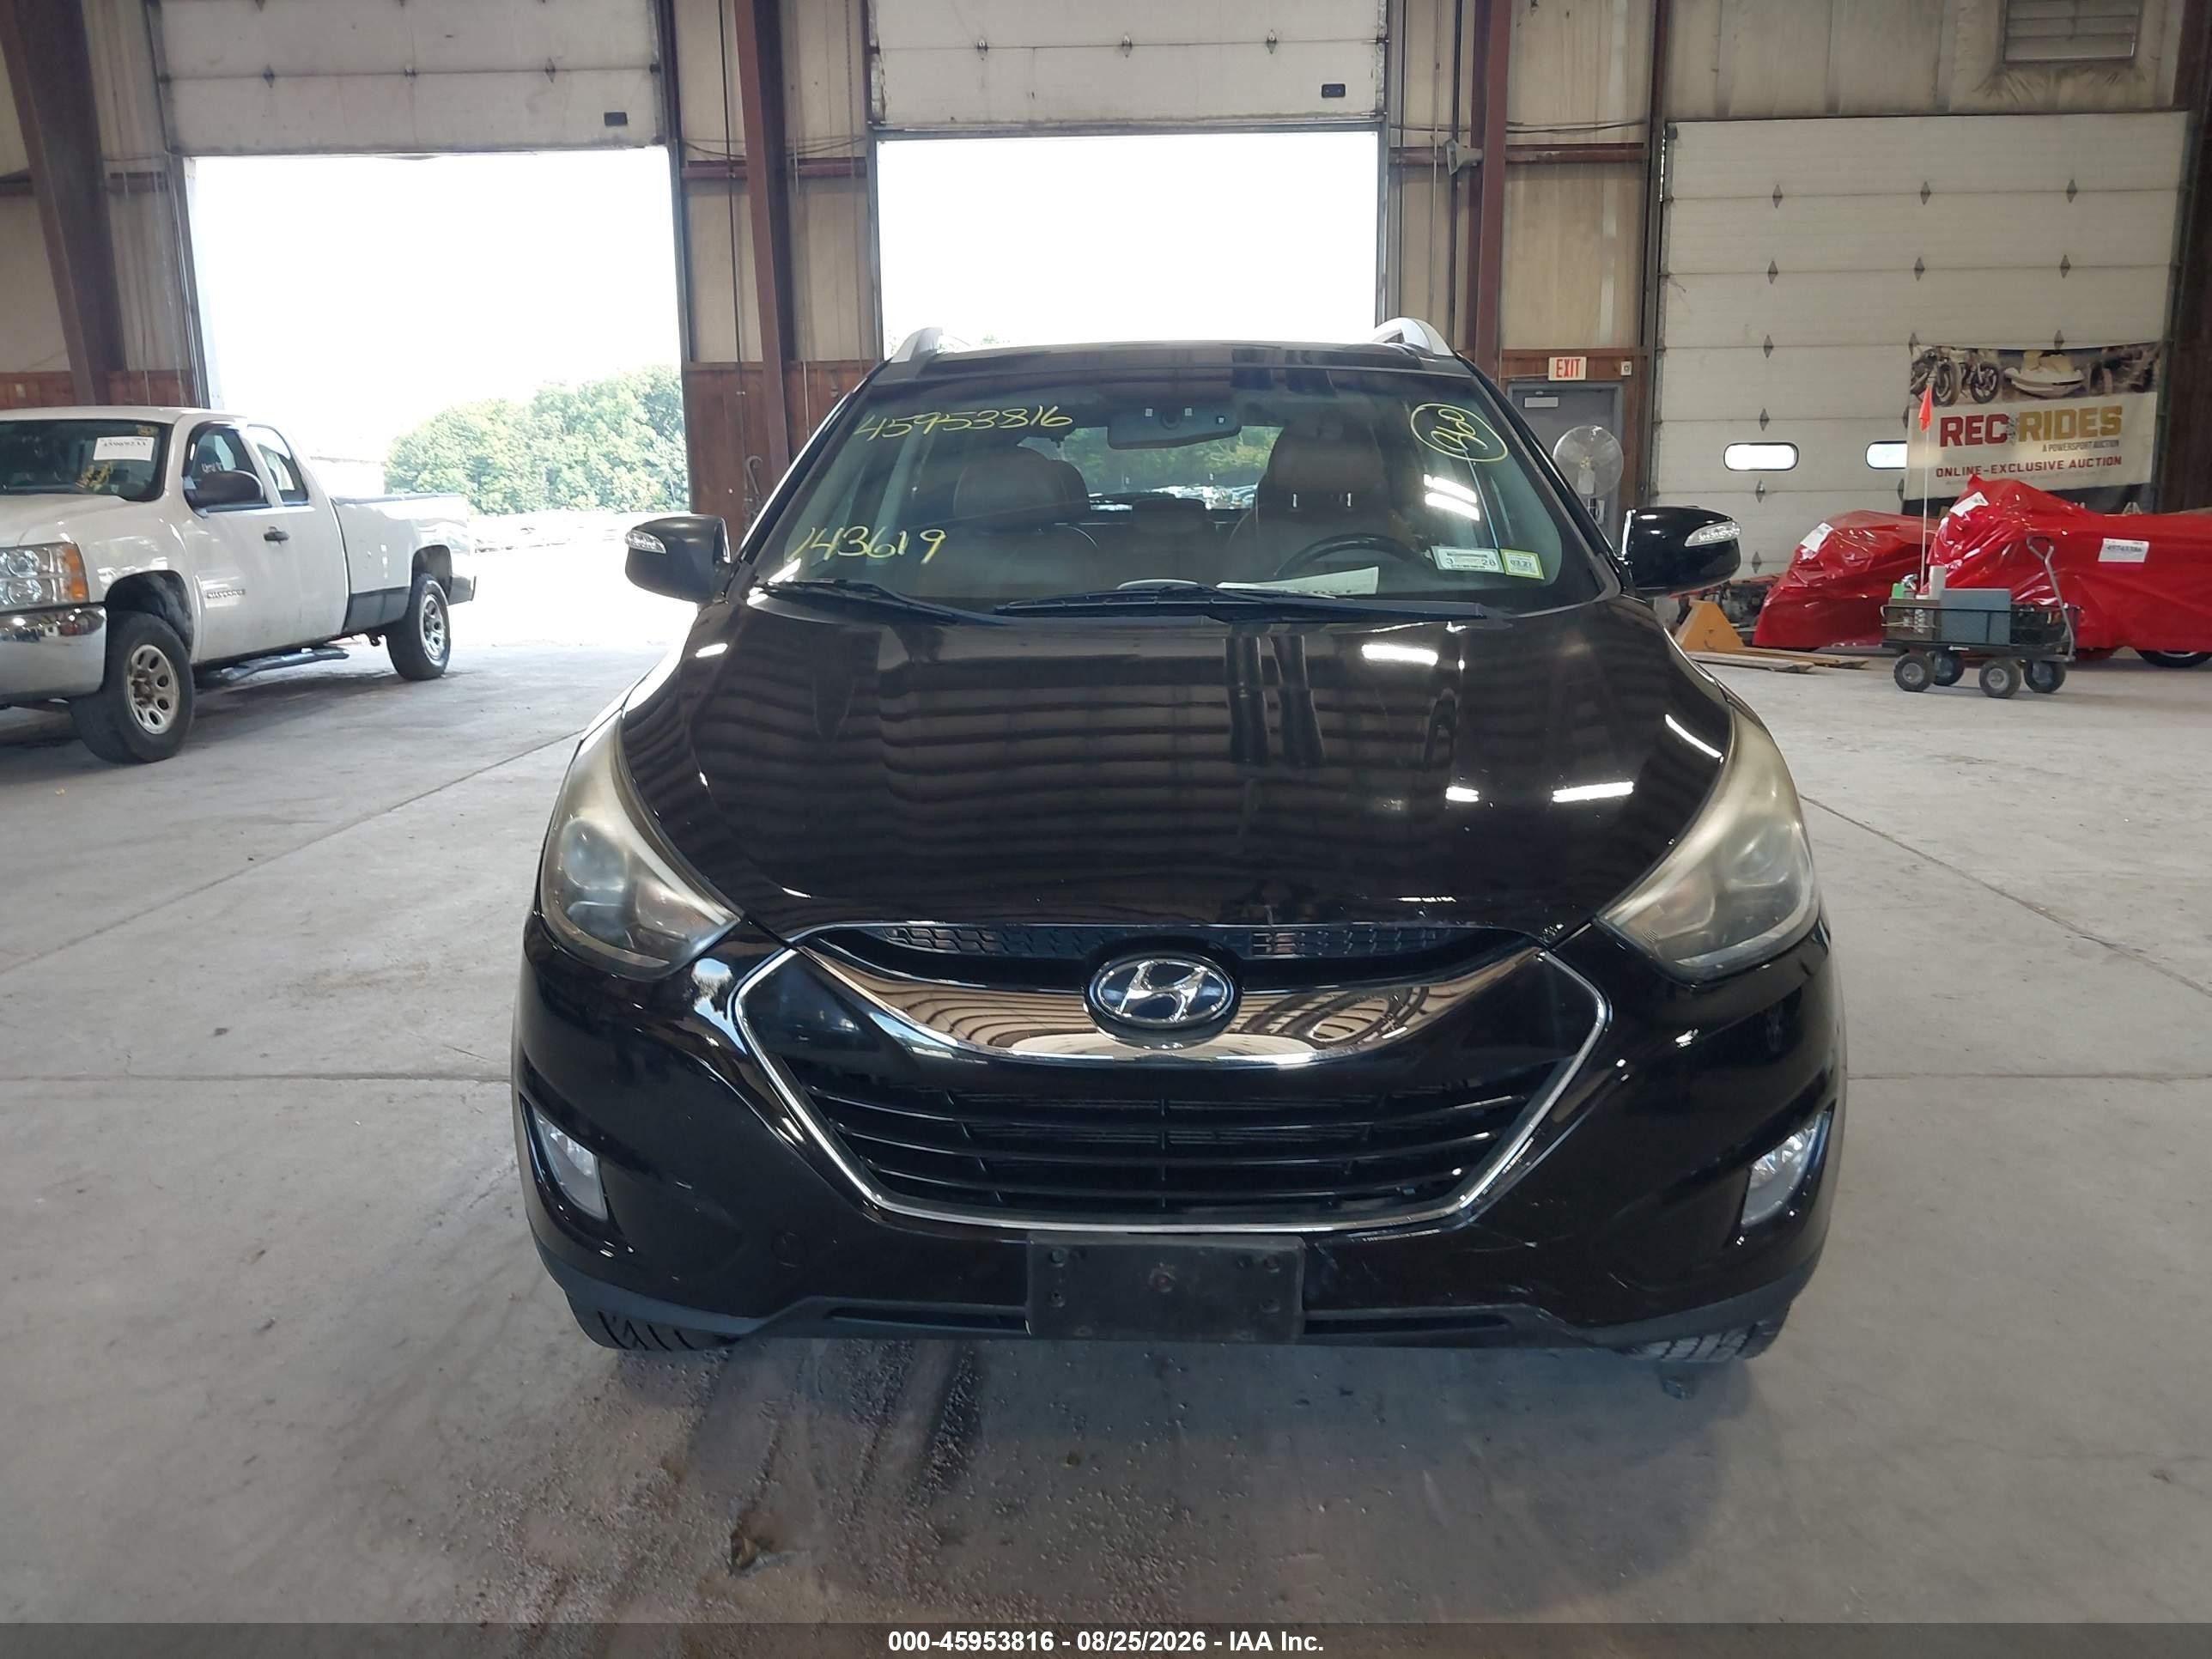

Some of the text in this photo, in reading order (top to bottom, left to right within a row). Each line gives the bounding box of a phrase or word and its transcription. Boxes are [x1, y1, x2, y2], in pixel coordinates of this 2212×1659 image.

[1555, 358, 1581, 379] EXIT
[854, 404, 1073, 441] 45953816
[1939, 412, 2009, 448] REC
[2017, 404, 2124, 443] RIDES
[1936, 459, 2064, 477] ONLINE-EXCLUSIVE
[2069, 455, 2123, 469] AUCTION
[786, 525, 947, 564] 143619
